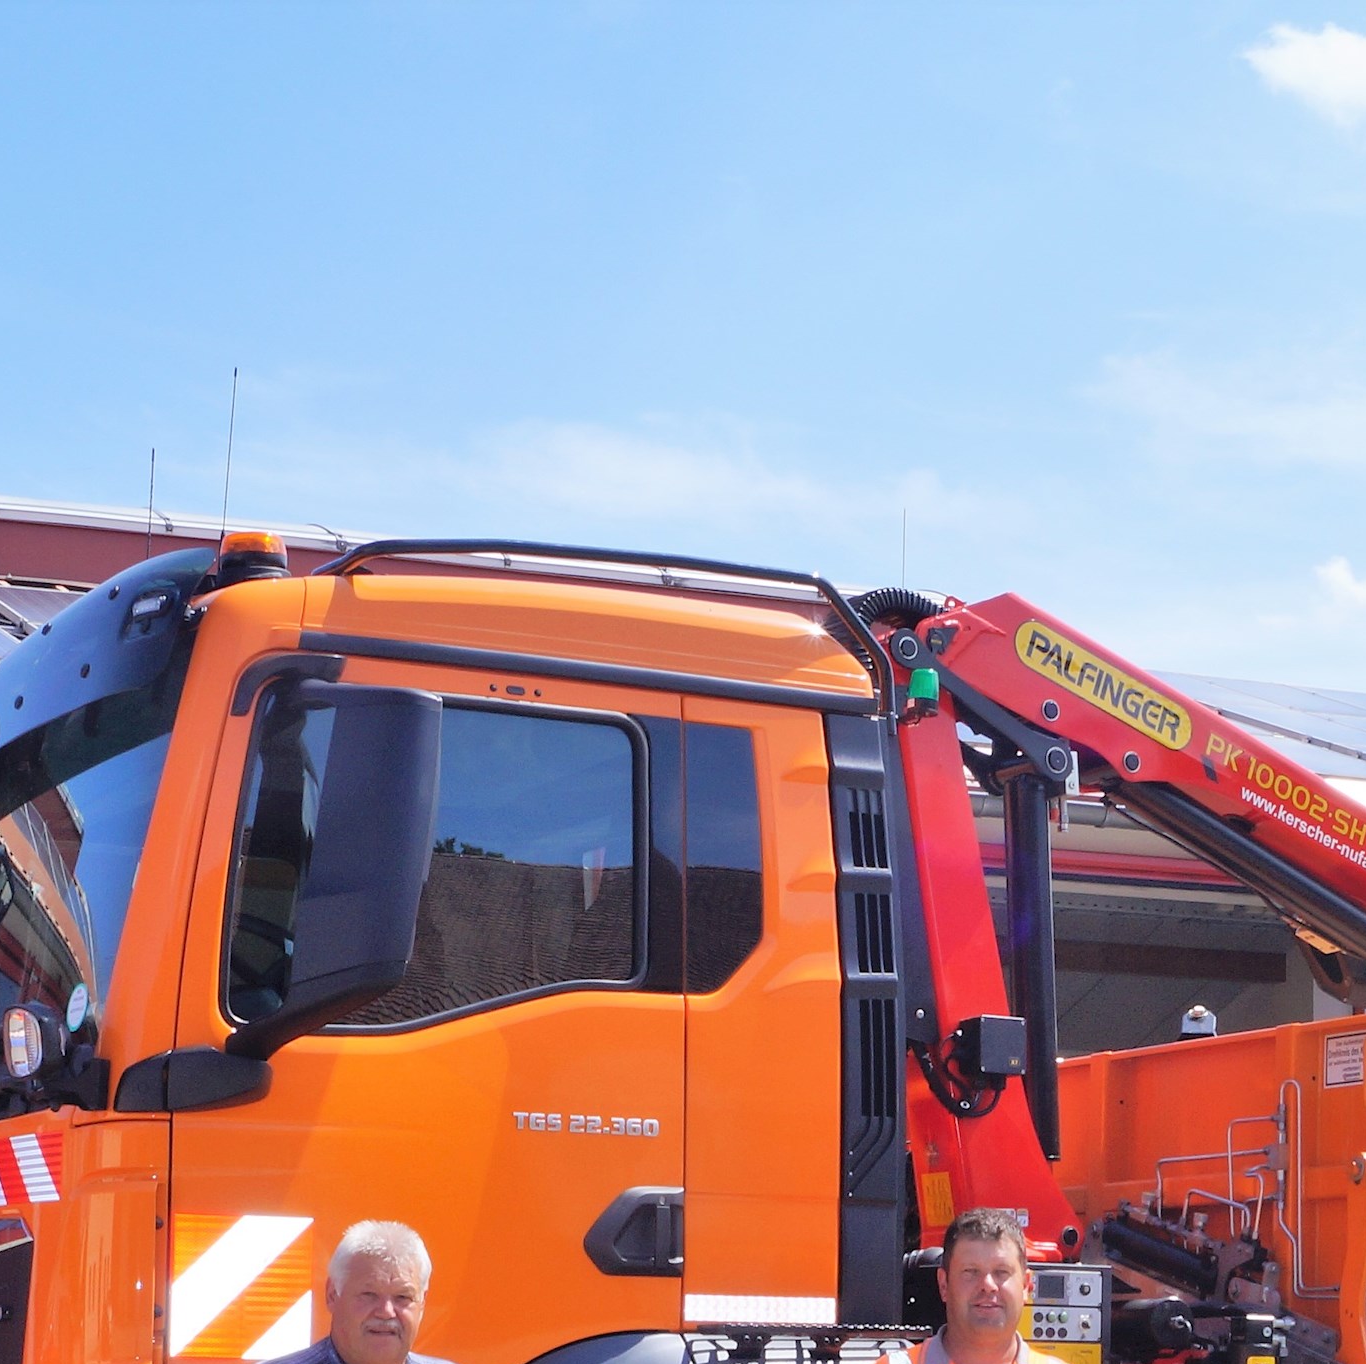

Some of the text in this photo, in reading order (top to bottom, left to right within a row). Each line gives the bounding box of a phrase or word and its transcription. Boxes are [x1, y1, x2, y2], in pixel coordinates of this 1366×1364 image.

[1026, 629, 1181, 742] PALFINGER
[1205, 732, 1245, 773] PK
[512, 1111, 660, 1137] TGS 22.360
